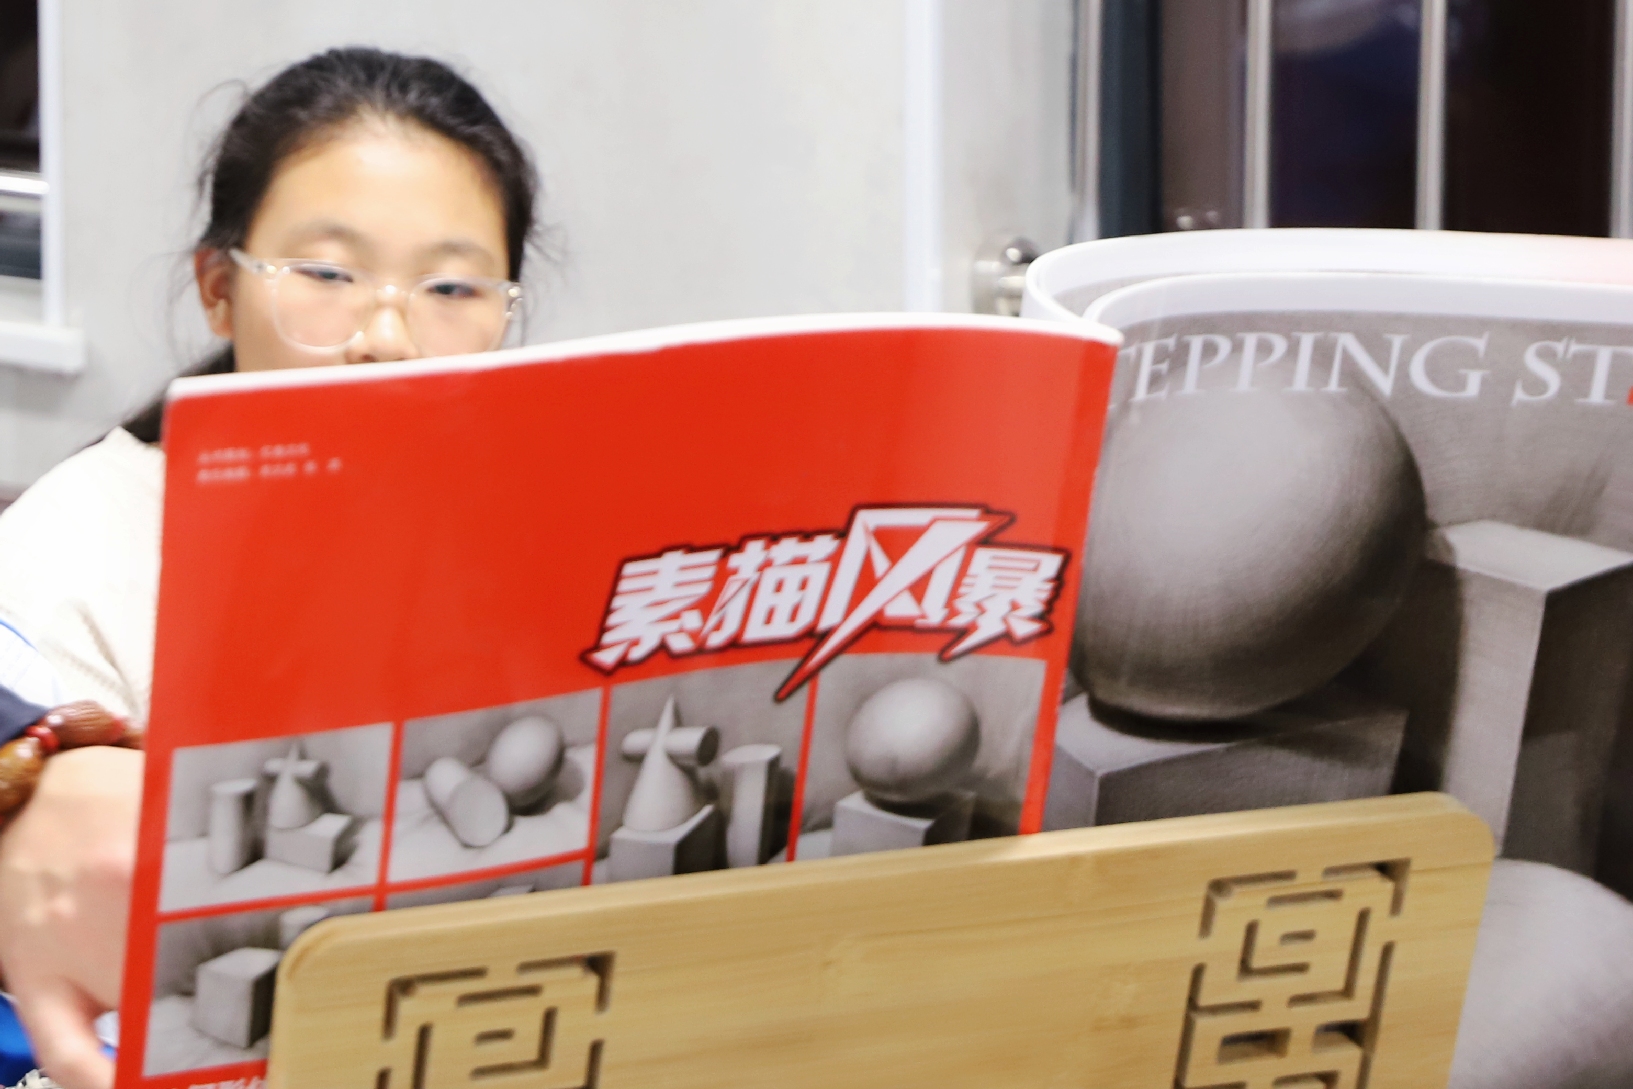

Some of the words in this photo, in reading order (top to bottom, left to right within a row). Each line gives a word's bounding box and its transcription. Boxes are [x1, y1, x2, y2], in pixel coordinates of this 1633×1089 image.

[1510, 337, 1633, 408] ST
[582, 505, 1072, 700] 素描风暴
